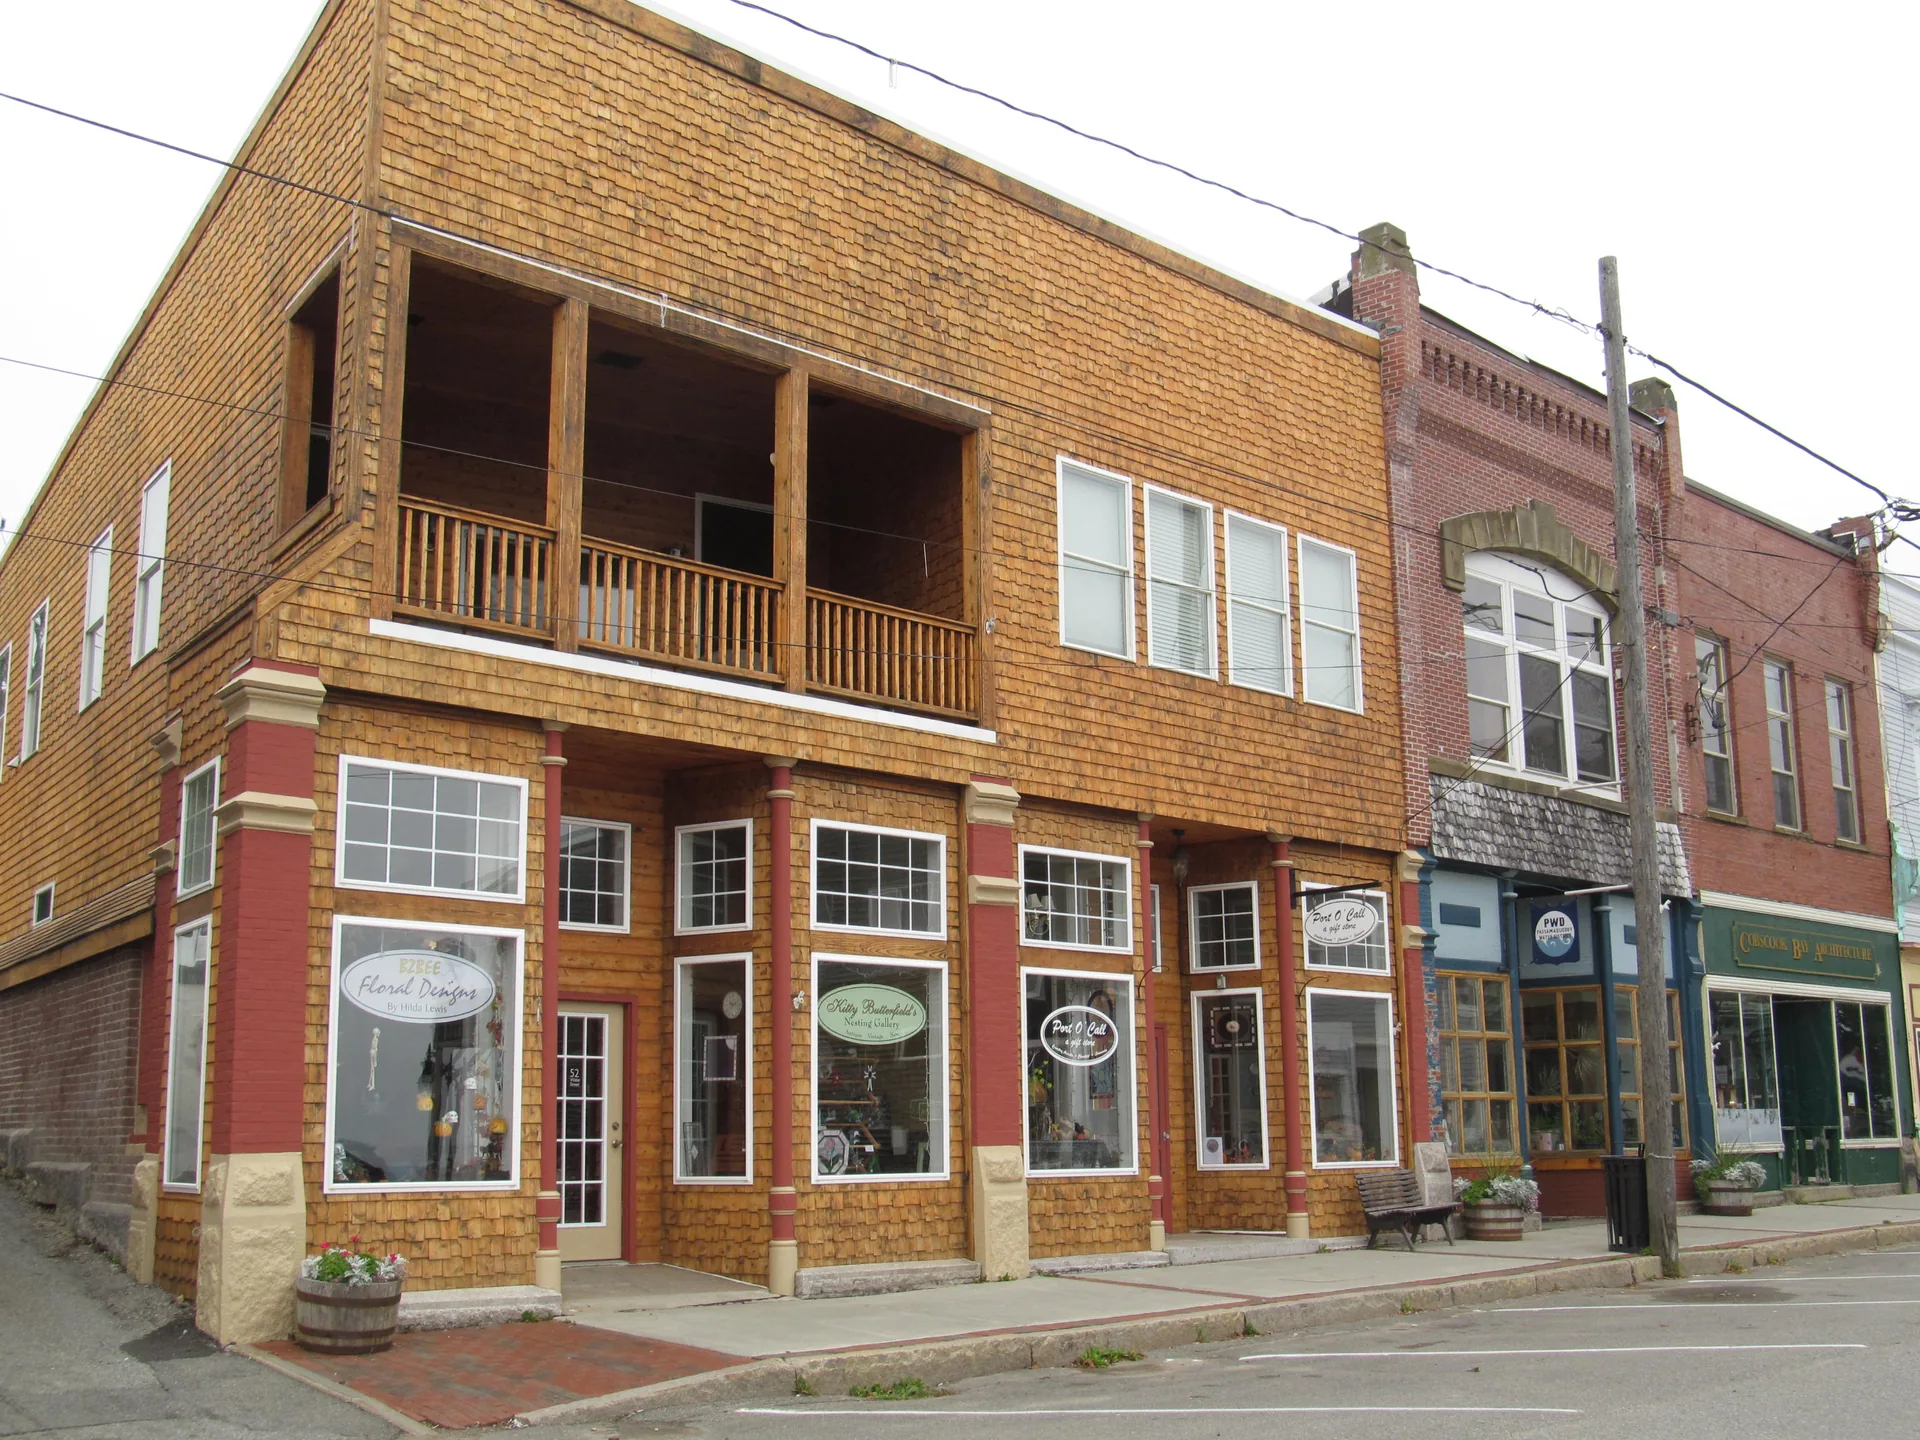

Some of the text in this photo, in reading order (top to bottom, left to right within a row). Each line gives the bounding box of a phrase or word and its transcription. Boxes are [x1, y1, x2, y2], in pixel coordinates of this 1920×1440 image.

[1312, 912, 1332, 924] Port
[1346, 907, 1366, 922] Call
[1329, 924, 1340, 934] gift
[1544, 917, 1565, 928] PWD
[1739, 931, 1872, 962] COBSCOOK BAY ARCHITECTURE
[357, 974, 478, 1006] Floral Designs
[387, 1001, 448, 1014] By Hilda Lewis
[826, 998, 917, 1020] Kitty Butterfield's
[844, 1017, 900, 1030] Nesting Gallery
[1052, 1019, 1073, 1034] Port
[1087, 1021, 1107, 1037] Call
[1070, 1037, 1081, 1047] gift
[569, 1068, 579, 1077] 52
